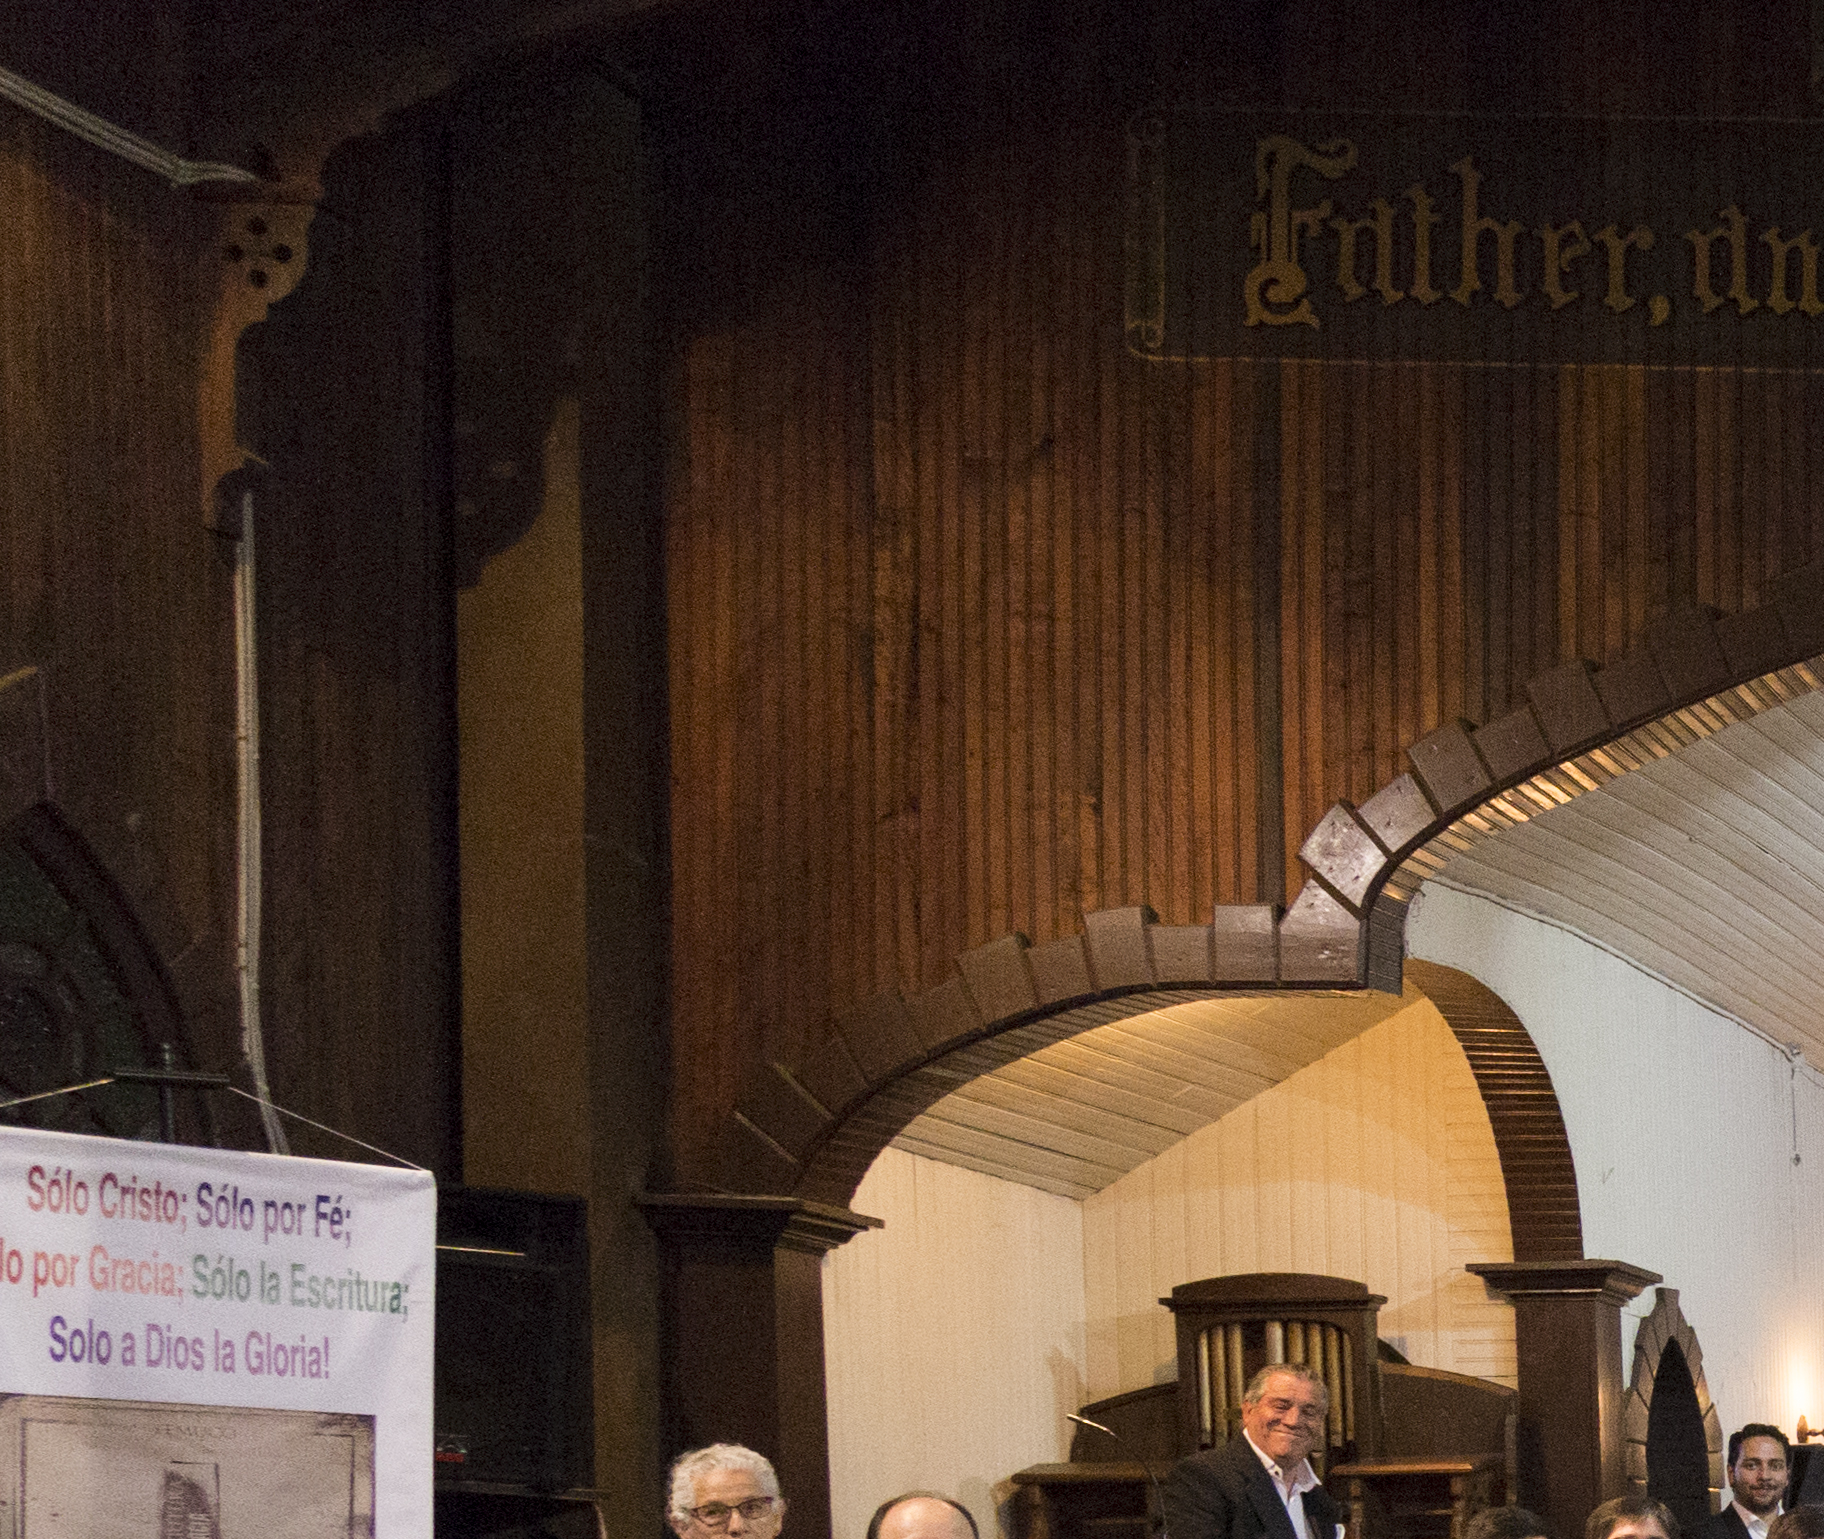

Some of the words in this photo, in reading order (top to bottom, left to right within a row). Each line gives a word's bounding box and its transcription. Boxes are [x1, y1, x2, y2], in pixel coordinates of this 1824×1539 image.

[27, 1163, 90, 1217] Sólo
[98, 1170, 187, 1235] Cristo;
[197, 1181, 254, 1231] Sólo
[263, 1195, 306, 1245] por
[33, 1250, 80, 1298] por
[192, 1253, 251, 1304] Sólo
[260, 1260, 282, 1305] la
[121, 1332, 136, 1367] a
[146, 1323, 205, 1372] Dios
[215, 1328, 236, 1373] la
[245, 1330, 330, 1380] Gloria!
